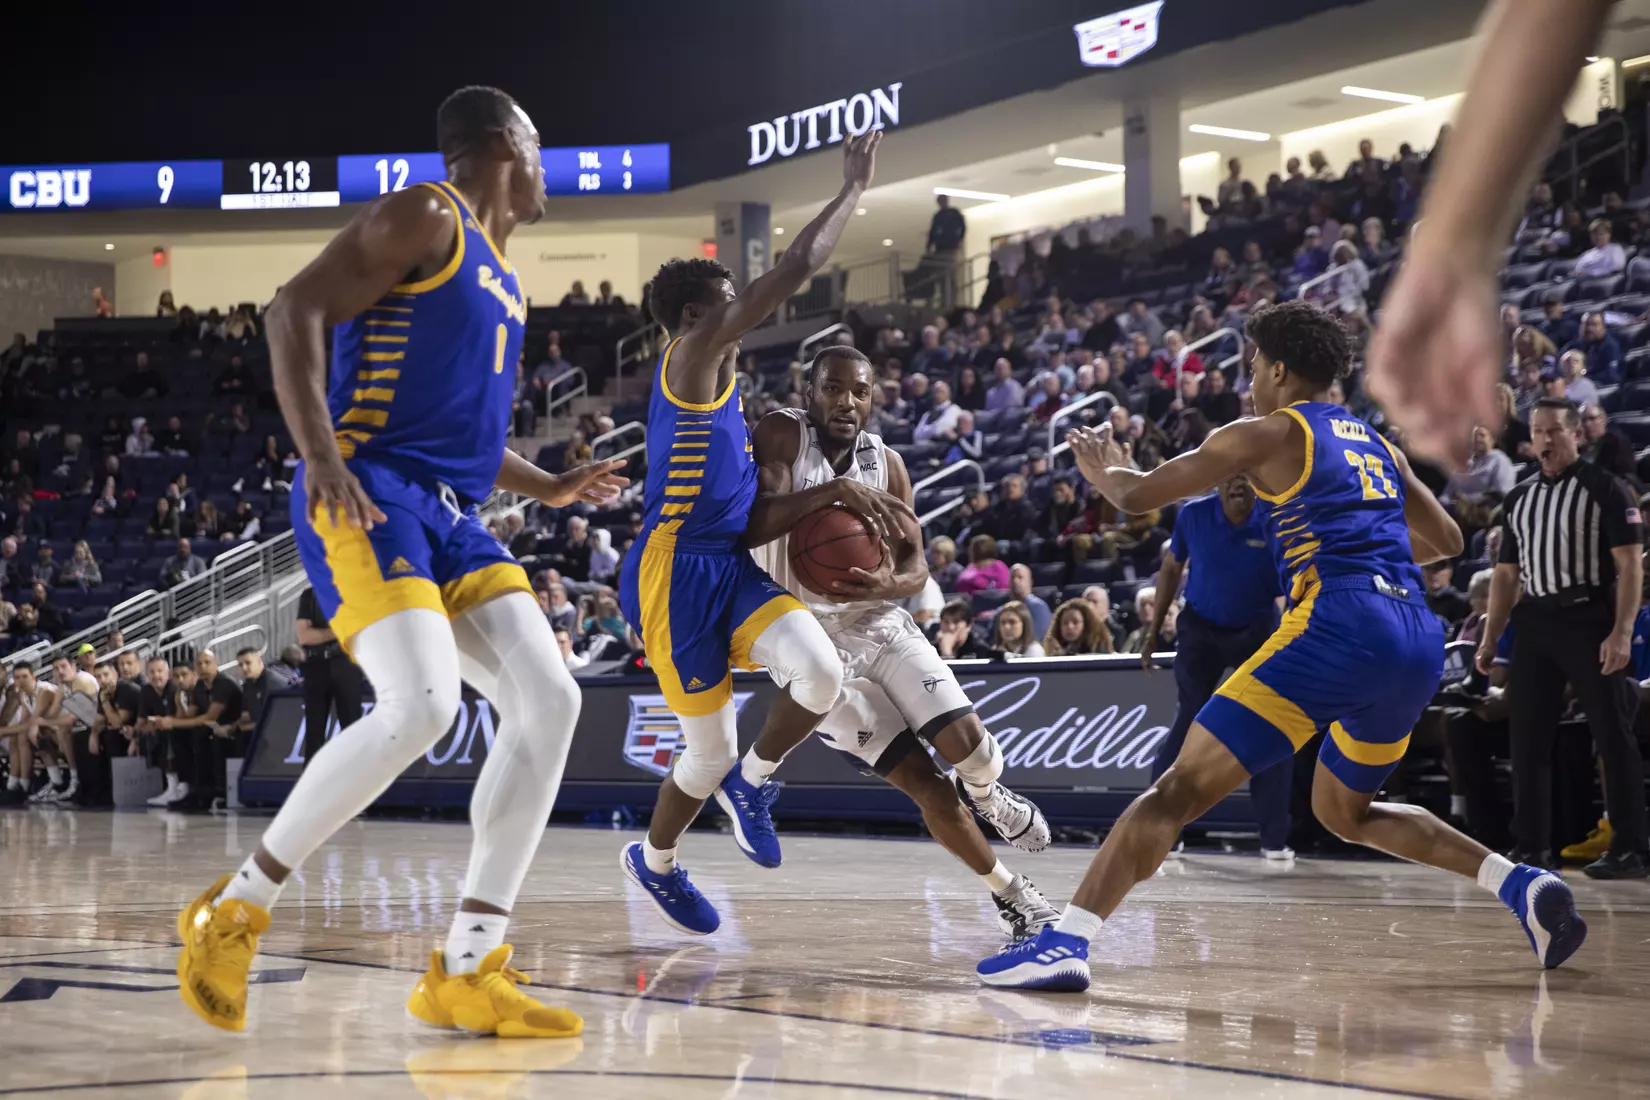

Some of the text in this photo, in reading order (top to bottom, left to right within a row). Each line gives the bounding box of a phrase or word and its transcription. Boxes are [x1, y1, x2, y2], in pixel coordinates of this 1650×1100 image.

[747, 82, 902, 166] DUTTON
[10, 165, 174, 208] CBU 9
[250, 160, 311, 193] 12:13
[374, 158, 409, 195] 12
[494, 322, 508, 374] 1
[1343, 449, 1398, 501] 22
[932, 676, 1171, 776] Cadilla
